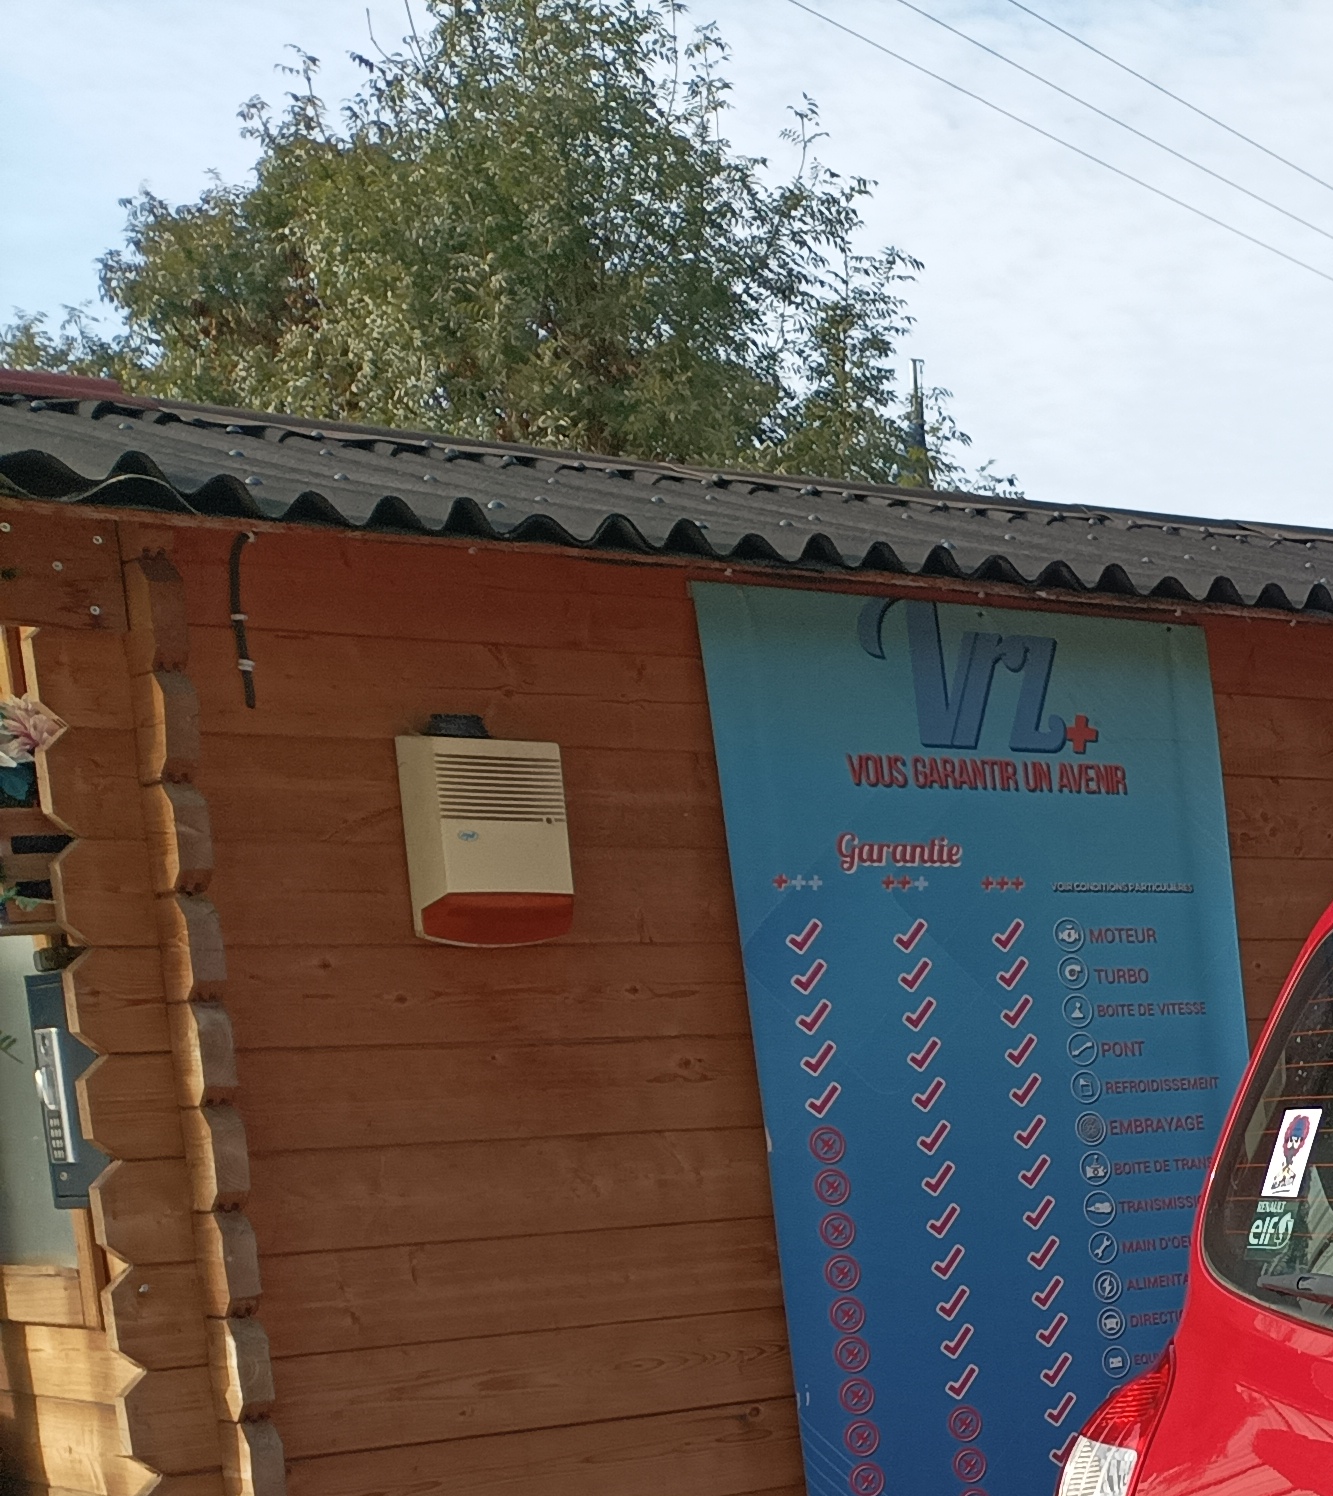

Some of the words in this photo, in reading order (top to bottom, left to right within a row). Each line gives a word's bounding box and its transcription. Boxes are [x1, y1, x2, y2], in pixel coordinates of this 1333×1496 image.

[847, 754, 907, 788] VOUS
[912, 756, 1019, 792] GARANTIR
[1023, 761, 1053, 793] UN
[1058, 763, 1129, 795] AVENIR
[836, 831, 963, 874] Garantie
[1052, 882, 1073, 893] VOIR
[1074, 882, 1127, 893] CONDITIONS
[1089, 927, 1158, 945] MOTEUR
[1093, 967, 1150, 985] TURBO
[1097, 1003, 1135, 1018] BOITE
[1138, 1003, 1155, 1017] DE
[1158, 1002, 1207, 1016] VITESSE
[1101, 1041, 1145, 1058] PONT
[1105, 1076, 1220, 1095] REFROIDISSEMENT
[1109, 1114, 1206, 1136] EMBRAYAGE
[1113, 1160, 1150, 1176] BOITE
[1153, 1159, 1171, 1173] DE
[1256, 1201, 1287, 1213] RENAULT
[1249, 1216, 1280, 1246] elf
[1121, 1239, 1157, 1255] MAIN
